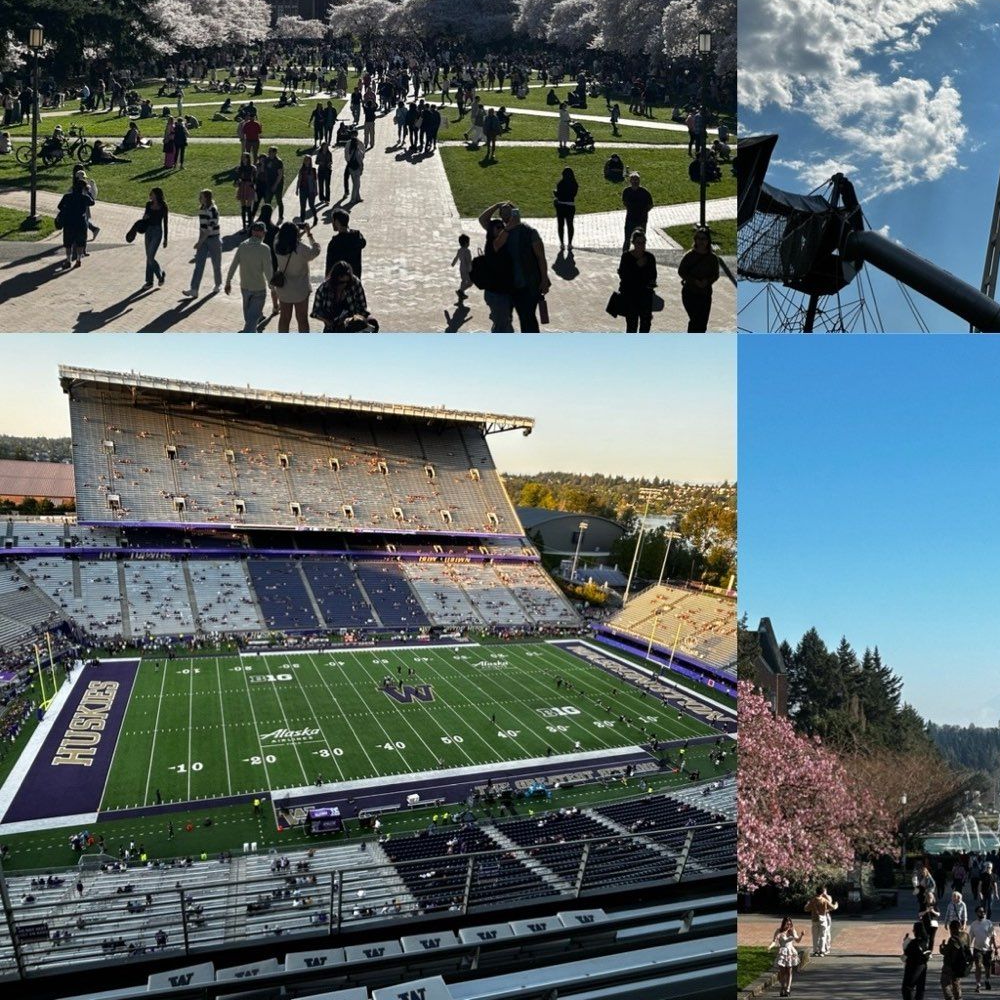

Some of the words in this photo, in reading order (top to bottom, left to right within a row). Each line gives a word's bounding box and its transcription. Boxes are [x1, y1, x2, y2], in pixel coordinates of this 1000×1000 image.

[376, 683, 436, 704] W
[51, 680, 119, 767] HUSKIES
[260, 727, 320, 740] Alaska
[441, 735, 464, 745] 50
[383, 741, 406, 751] 40
[318, 747, 344, 758] 30
[250, 755, 277, 765] 20
[177, 762, 204, 773] 10
[363, 948, 386, 959] W
[304, 957, 327, 968] W
[168, 972, 194, 987] W
